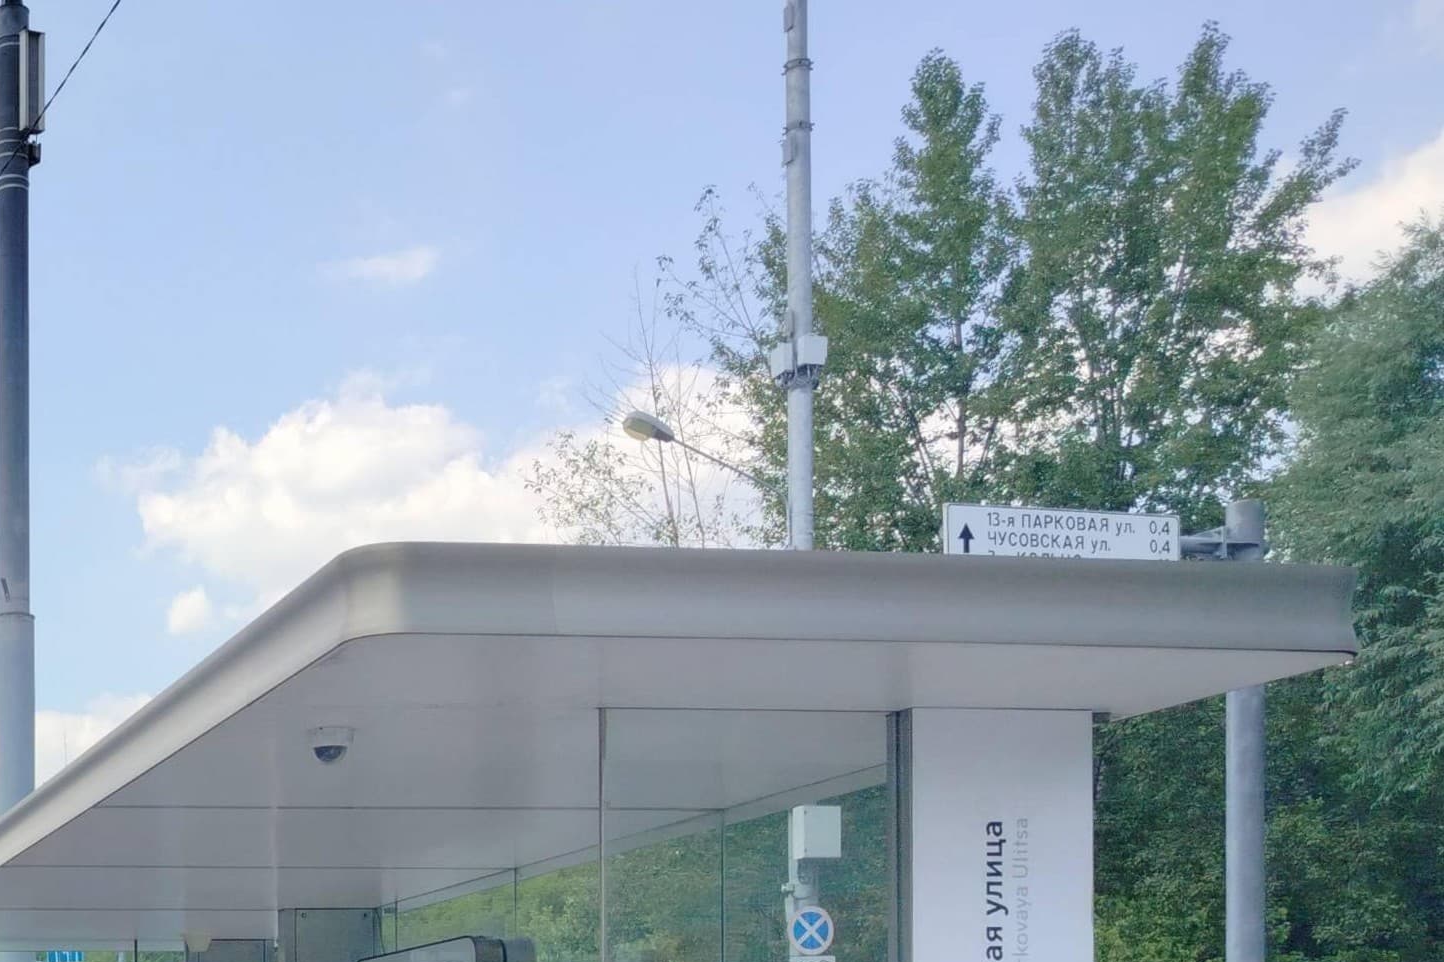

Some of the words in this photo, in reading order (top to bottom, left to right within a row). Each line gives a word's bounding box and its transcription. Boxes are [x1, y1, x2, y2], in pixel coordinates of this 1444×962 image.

[987, 512, 1015, 527] 13-я
[1021, 514, 1109, 533] ПАРКОВАЯ
[1116, 522, 1136, 536] ул.
[987, 531, 1085, 550] ЧУСОВСКАЯ
[1091, 539, 1111, 553] ул.
[986, 820, 1009, 916] улица
[1012, 817, 1030, 880] Ulitsa
